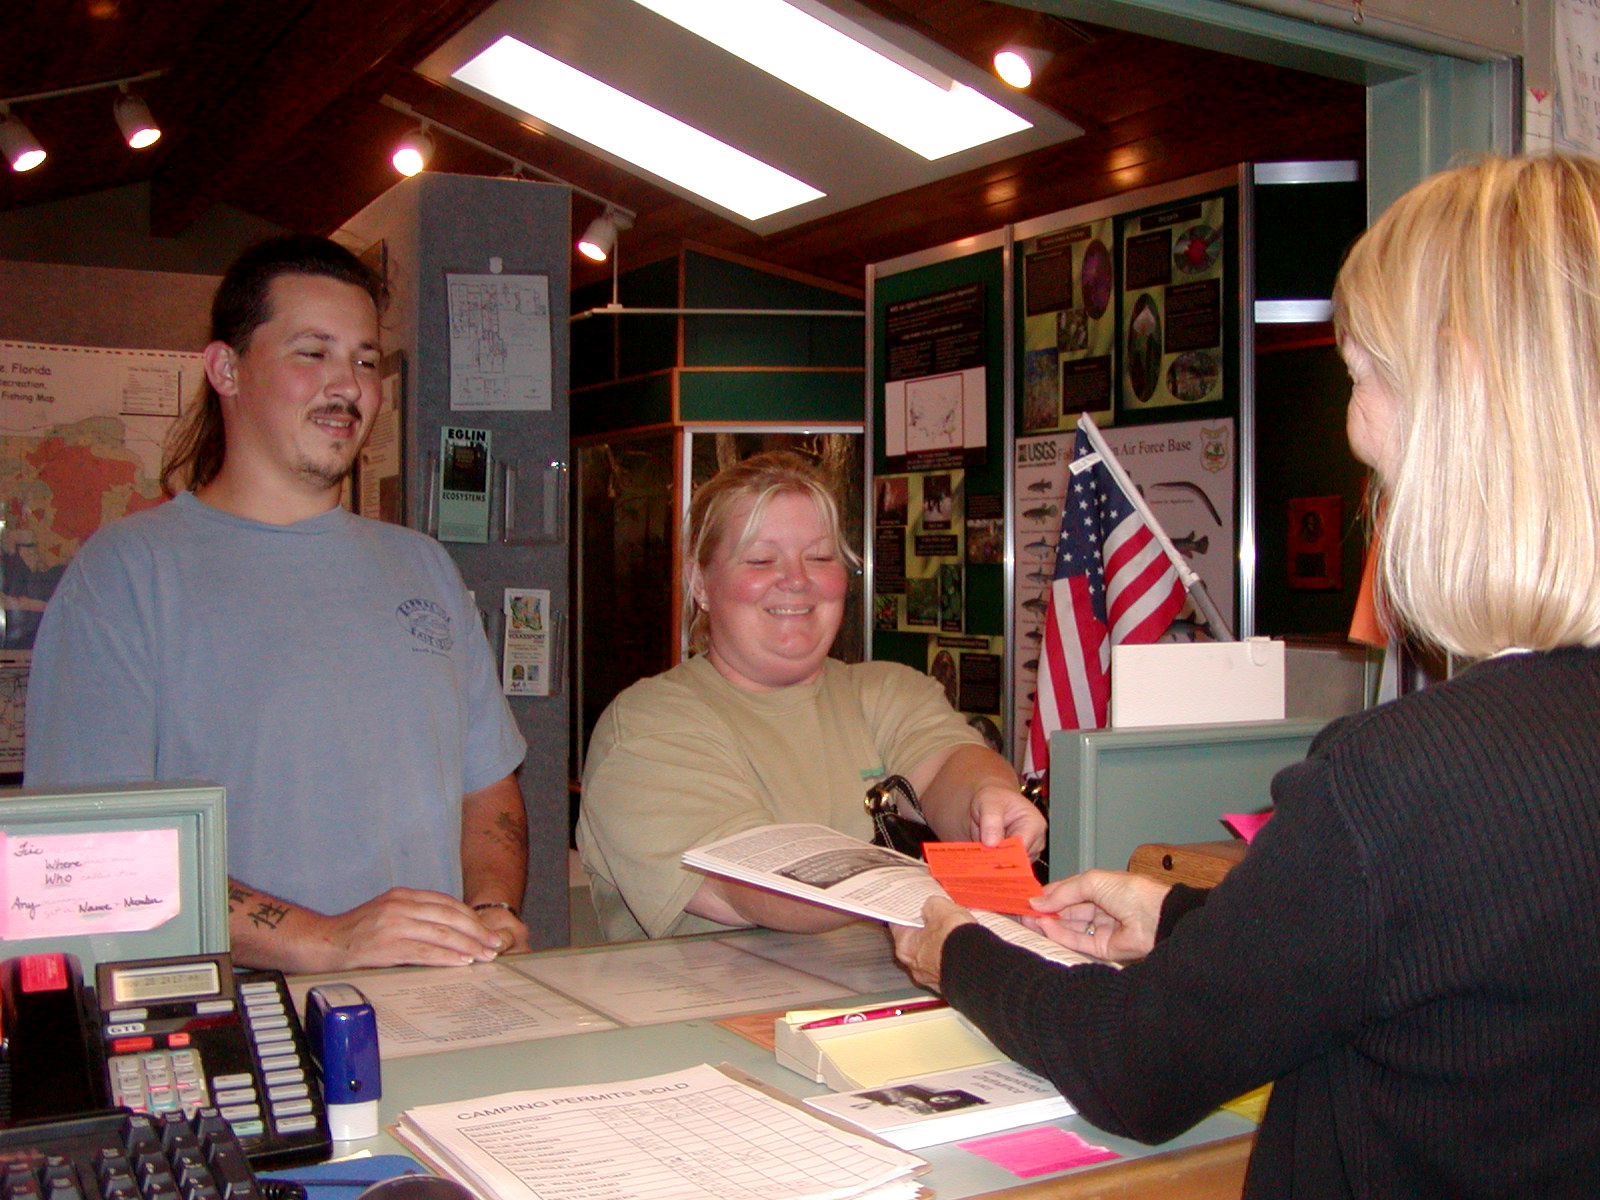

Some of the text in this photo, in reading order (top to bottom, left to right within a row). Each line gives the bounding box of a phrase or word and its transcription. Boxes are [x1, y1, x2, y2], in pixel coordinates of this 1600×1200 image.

[11, 363, 52, 376] Florida
[1, 391, 55, 404] Fishing Map
[448, 428, 487, 442] EGLIN
[1028, 440, 1057, 461] USGS
[1122, 440, 1139, 456] Air
[1140, 440, 1164, 454] Force
[1168, 437, 1192, 452] Base
[442, 491, 486, 502] ECOSYSTEMS
[45, 858, 82, 870] Where
[45, 872, 72, 885] Who
[79, 901, 112, 913] Name
[457, 1082, 690, 1120] CAMPING PERMITS SOLD
